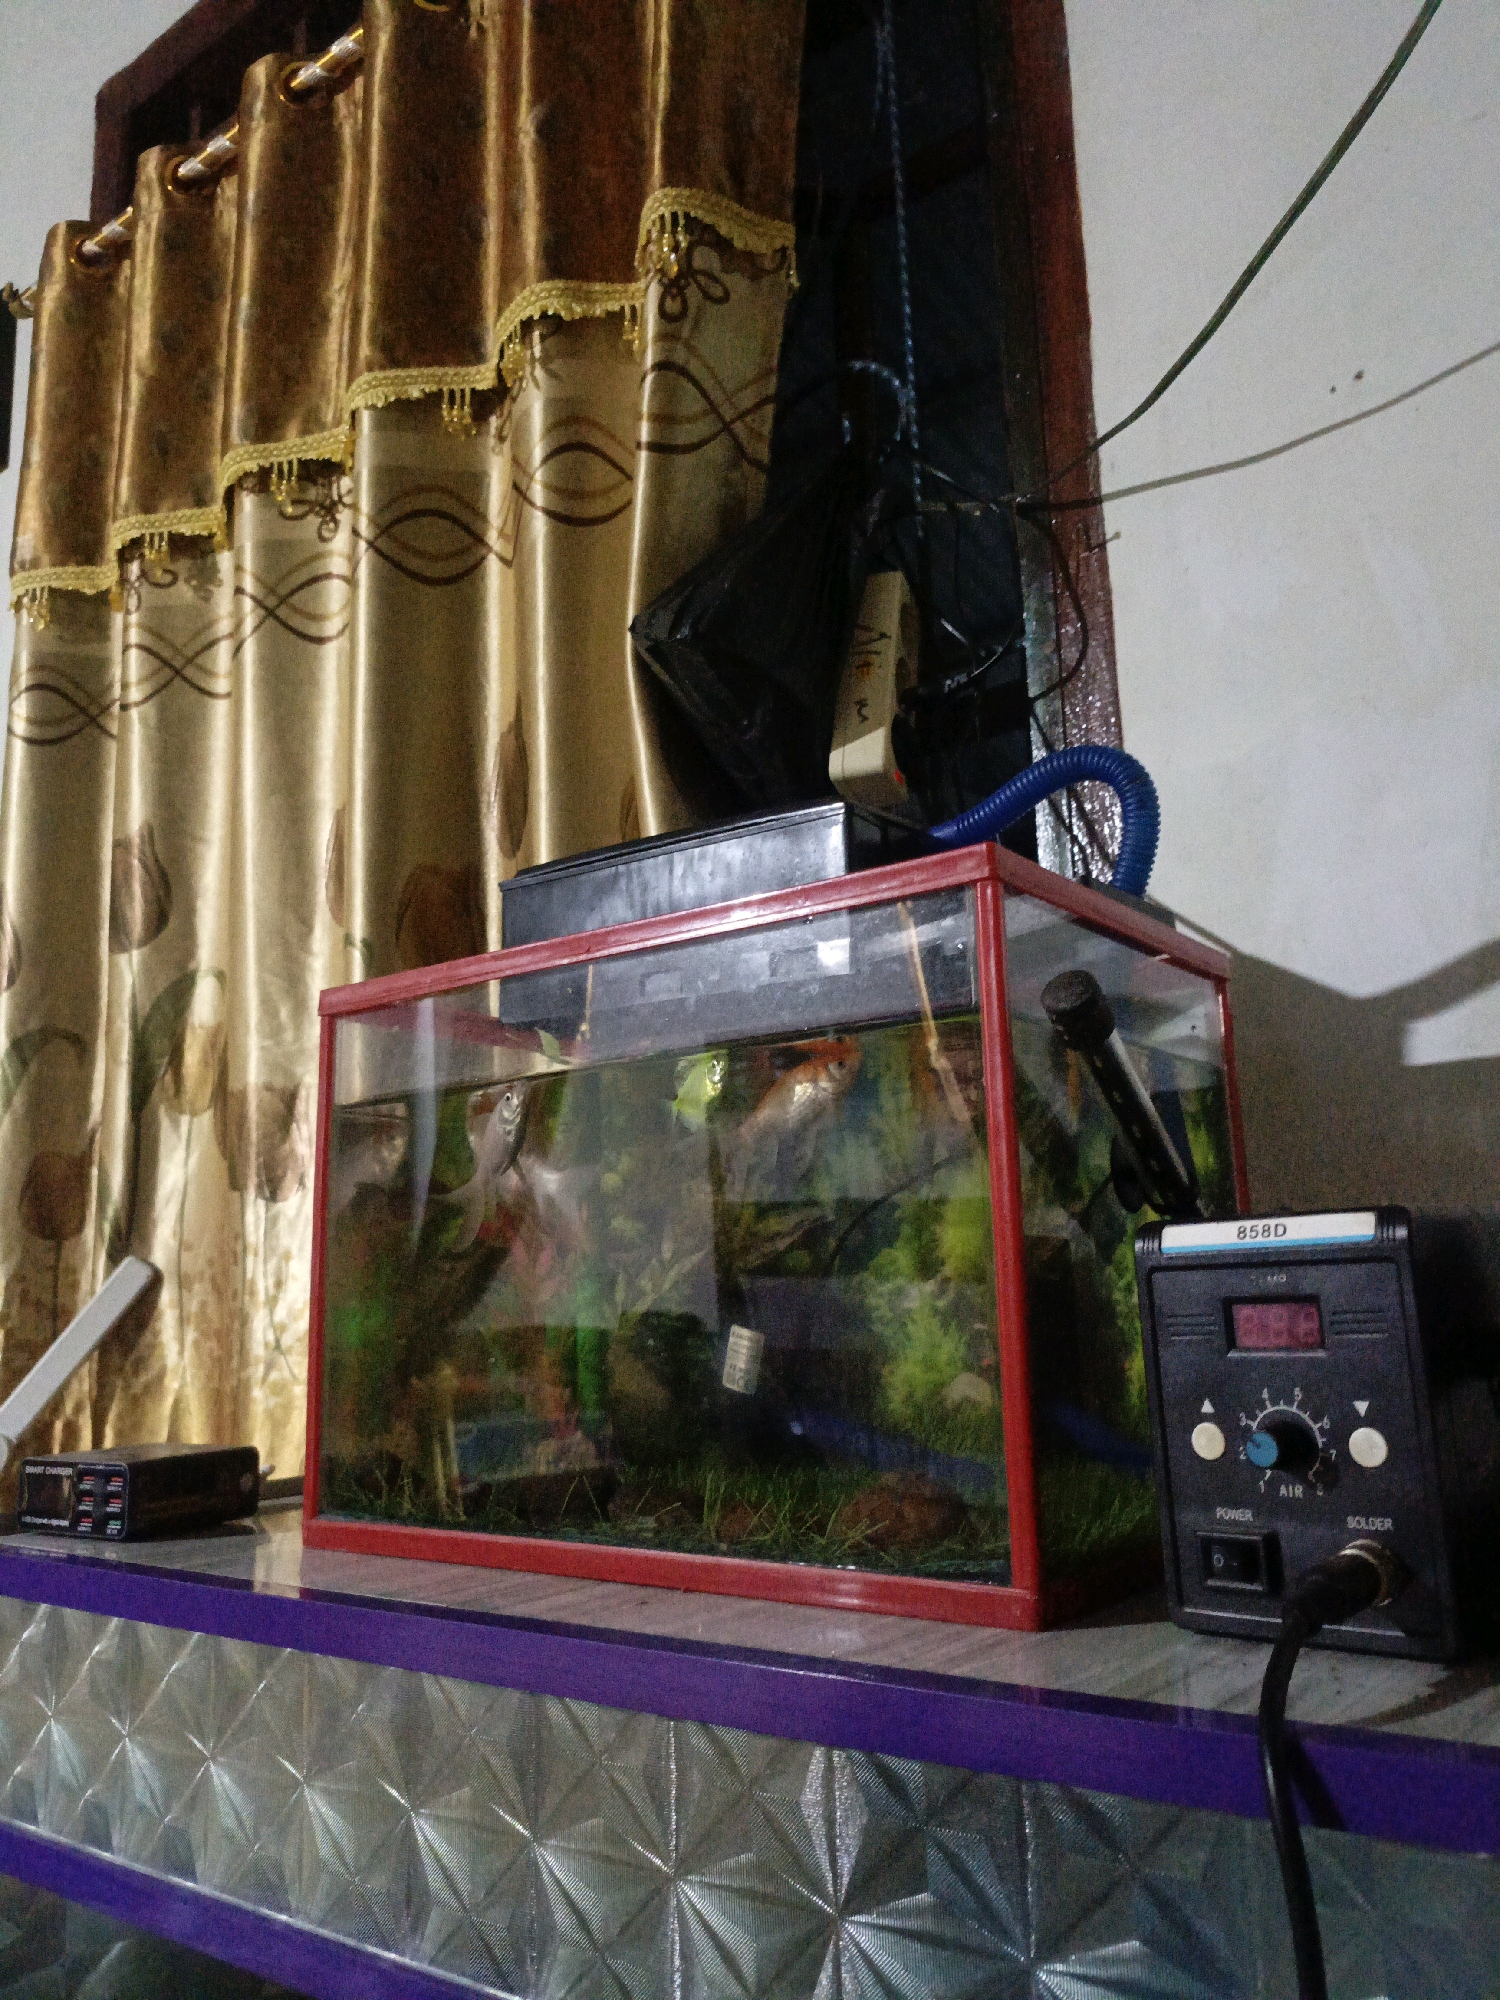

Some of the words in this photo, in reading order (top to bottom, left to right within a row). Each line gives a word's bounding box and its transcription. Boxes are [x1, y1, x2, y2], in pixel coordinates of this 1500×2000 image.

[1237, 1223, 1288, 1241] 858D
[1261, 1387, 1270, 1399] 4
[1294, 1387, 1303, 1401] 5
[1239, 1411, 1247, 1427] 3
[1322, 1415, 1331, 1430] 6
[1239, 1446, 1247, 1460] 2
[1329, 1449, 1337, 1461] 7
[25, 1465, 45, 1474] SMART
[45, 1466, 73, 1476] CHARGER
[1279, 1484, 1304, 1499] AIR
[1216, 1506, 1254, 1522] POWER
[1346, 1515, 1395, 1532] SOLDER
